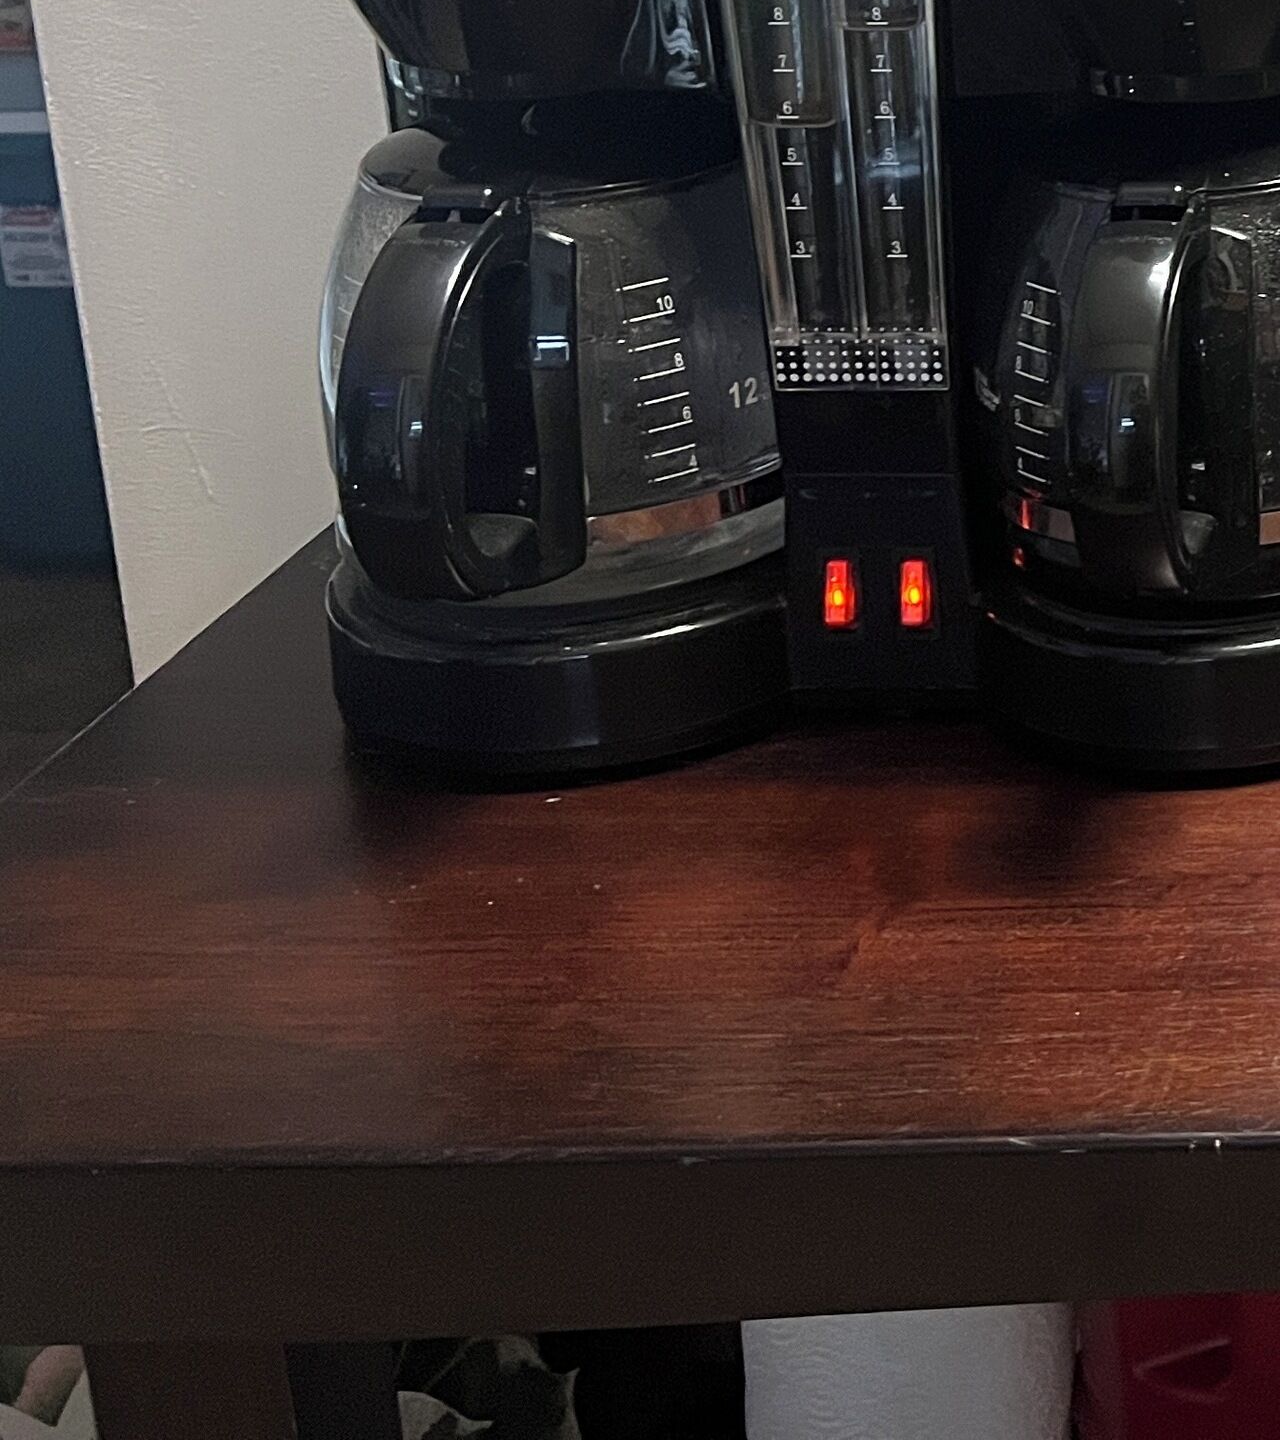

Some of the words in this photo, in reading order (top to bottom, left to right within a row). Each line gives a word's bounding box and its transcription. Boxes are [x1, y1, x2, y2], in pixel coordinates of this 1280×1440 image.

[773, 8, 783, 20] 8
[871, 7, 882, 20] 8
[777, 54, 787, 68] 7
[875, 54, 885, 68] 7
[782, 101, 793, 114] 6
[880, 101, 891, 114] 6
[787, 147, 797, 160] 5
[791, 193, 801, 206] 4
[887, 193, 898, 206] 4
[796, 241, 805, 254] 3
[891, 240, 901, 254] 3
[656, 294, 674, 311] 10
[674, 352, 684, 367] 8
[728, 377, 760, 408] 12
[682, 406, 692, 420] 6
